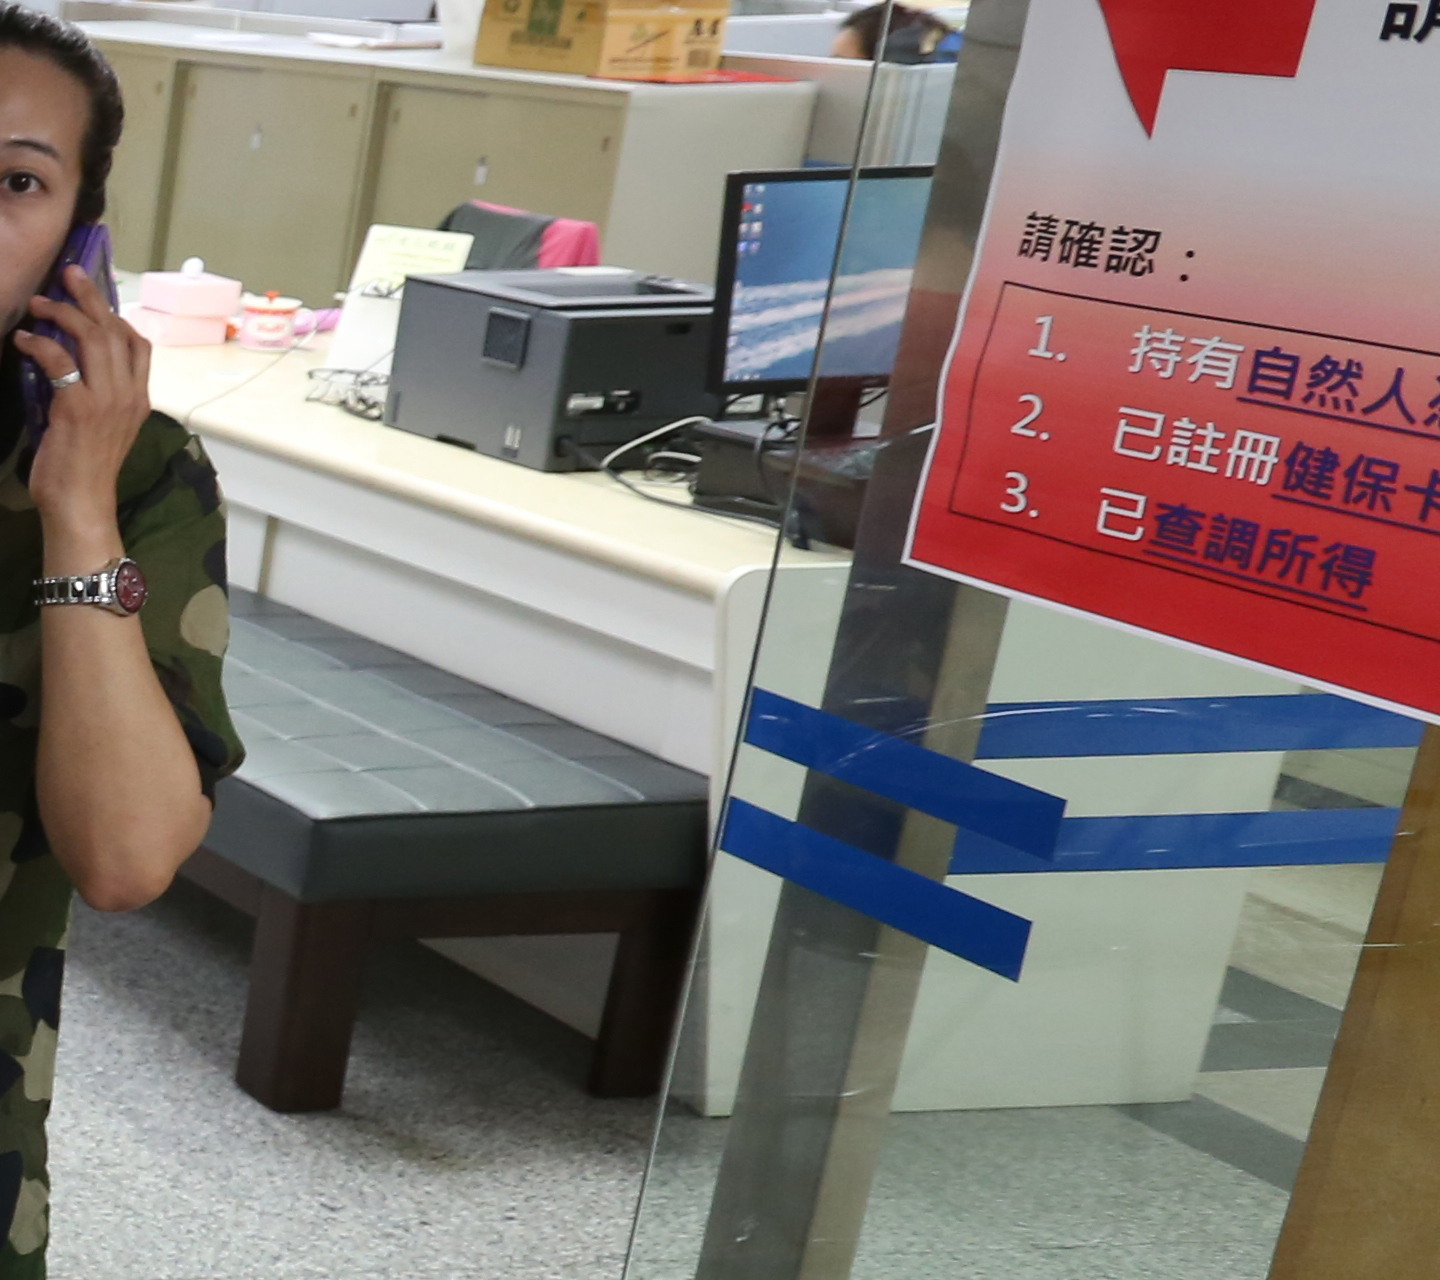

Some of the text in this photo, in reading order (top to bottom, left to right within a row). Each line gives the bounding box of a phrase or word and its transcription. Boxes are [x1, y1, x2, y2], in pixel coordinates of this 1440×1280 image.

[1027, 316, 1068, 362] 1.
[1009, 393, 1051, 442] 2.
[998, 471, 1377, 600] 3. 已查調所得
